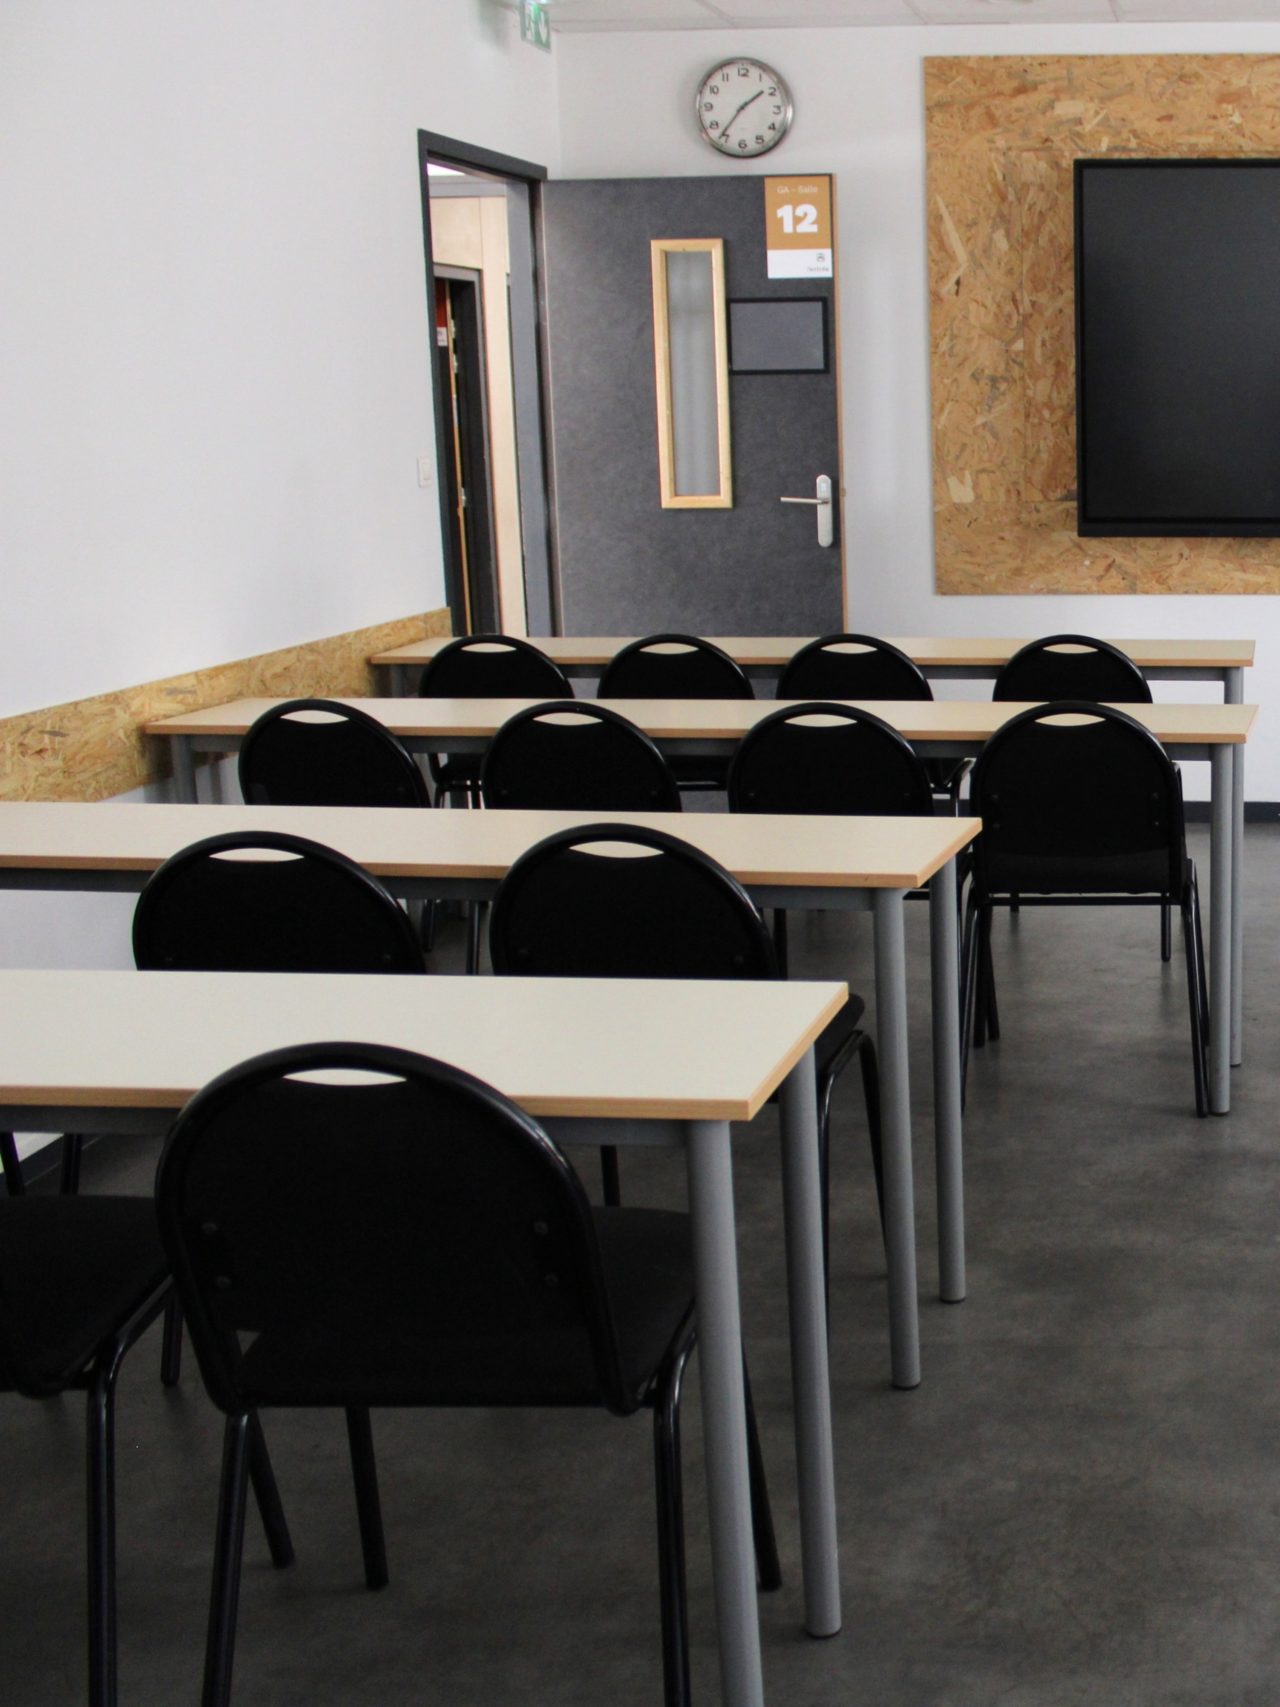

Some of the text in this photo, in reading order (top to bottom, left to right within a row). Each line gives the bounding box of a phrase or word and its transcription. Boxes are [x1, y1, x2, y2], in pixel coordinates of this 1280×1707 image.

[737, 66, 750, 77] 12
[722, 73, 729, 82] 11
[709, 85, 719, 95] 10
[767, 87, 777, 96] 2
[704, 102, 714, 112] 9
[772, 105, 782, 115] 3
[709, 120, 719, 130] 8
[767, 122, 776, 131] 4
[738, 139, 748, 149] 6
[755, 135, 765, 145] 5
[798, 184, 818, 194] Salle
[776, 203, 818, 234] 12
